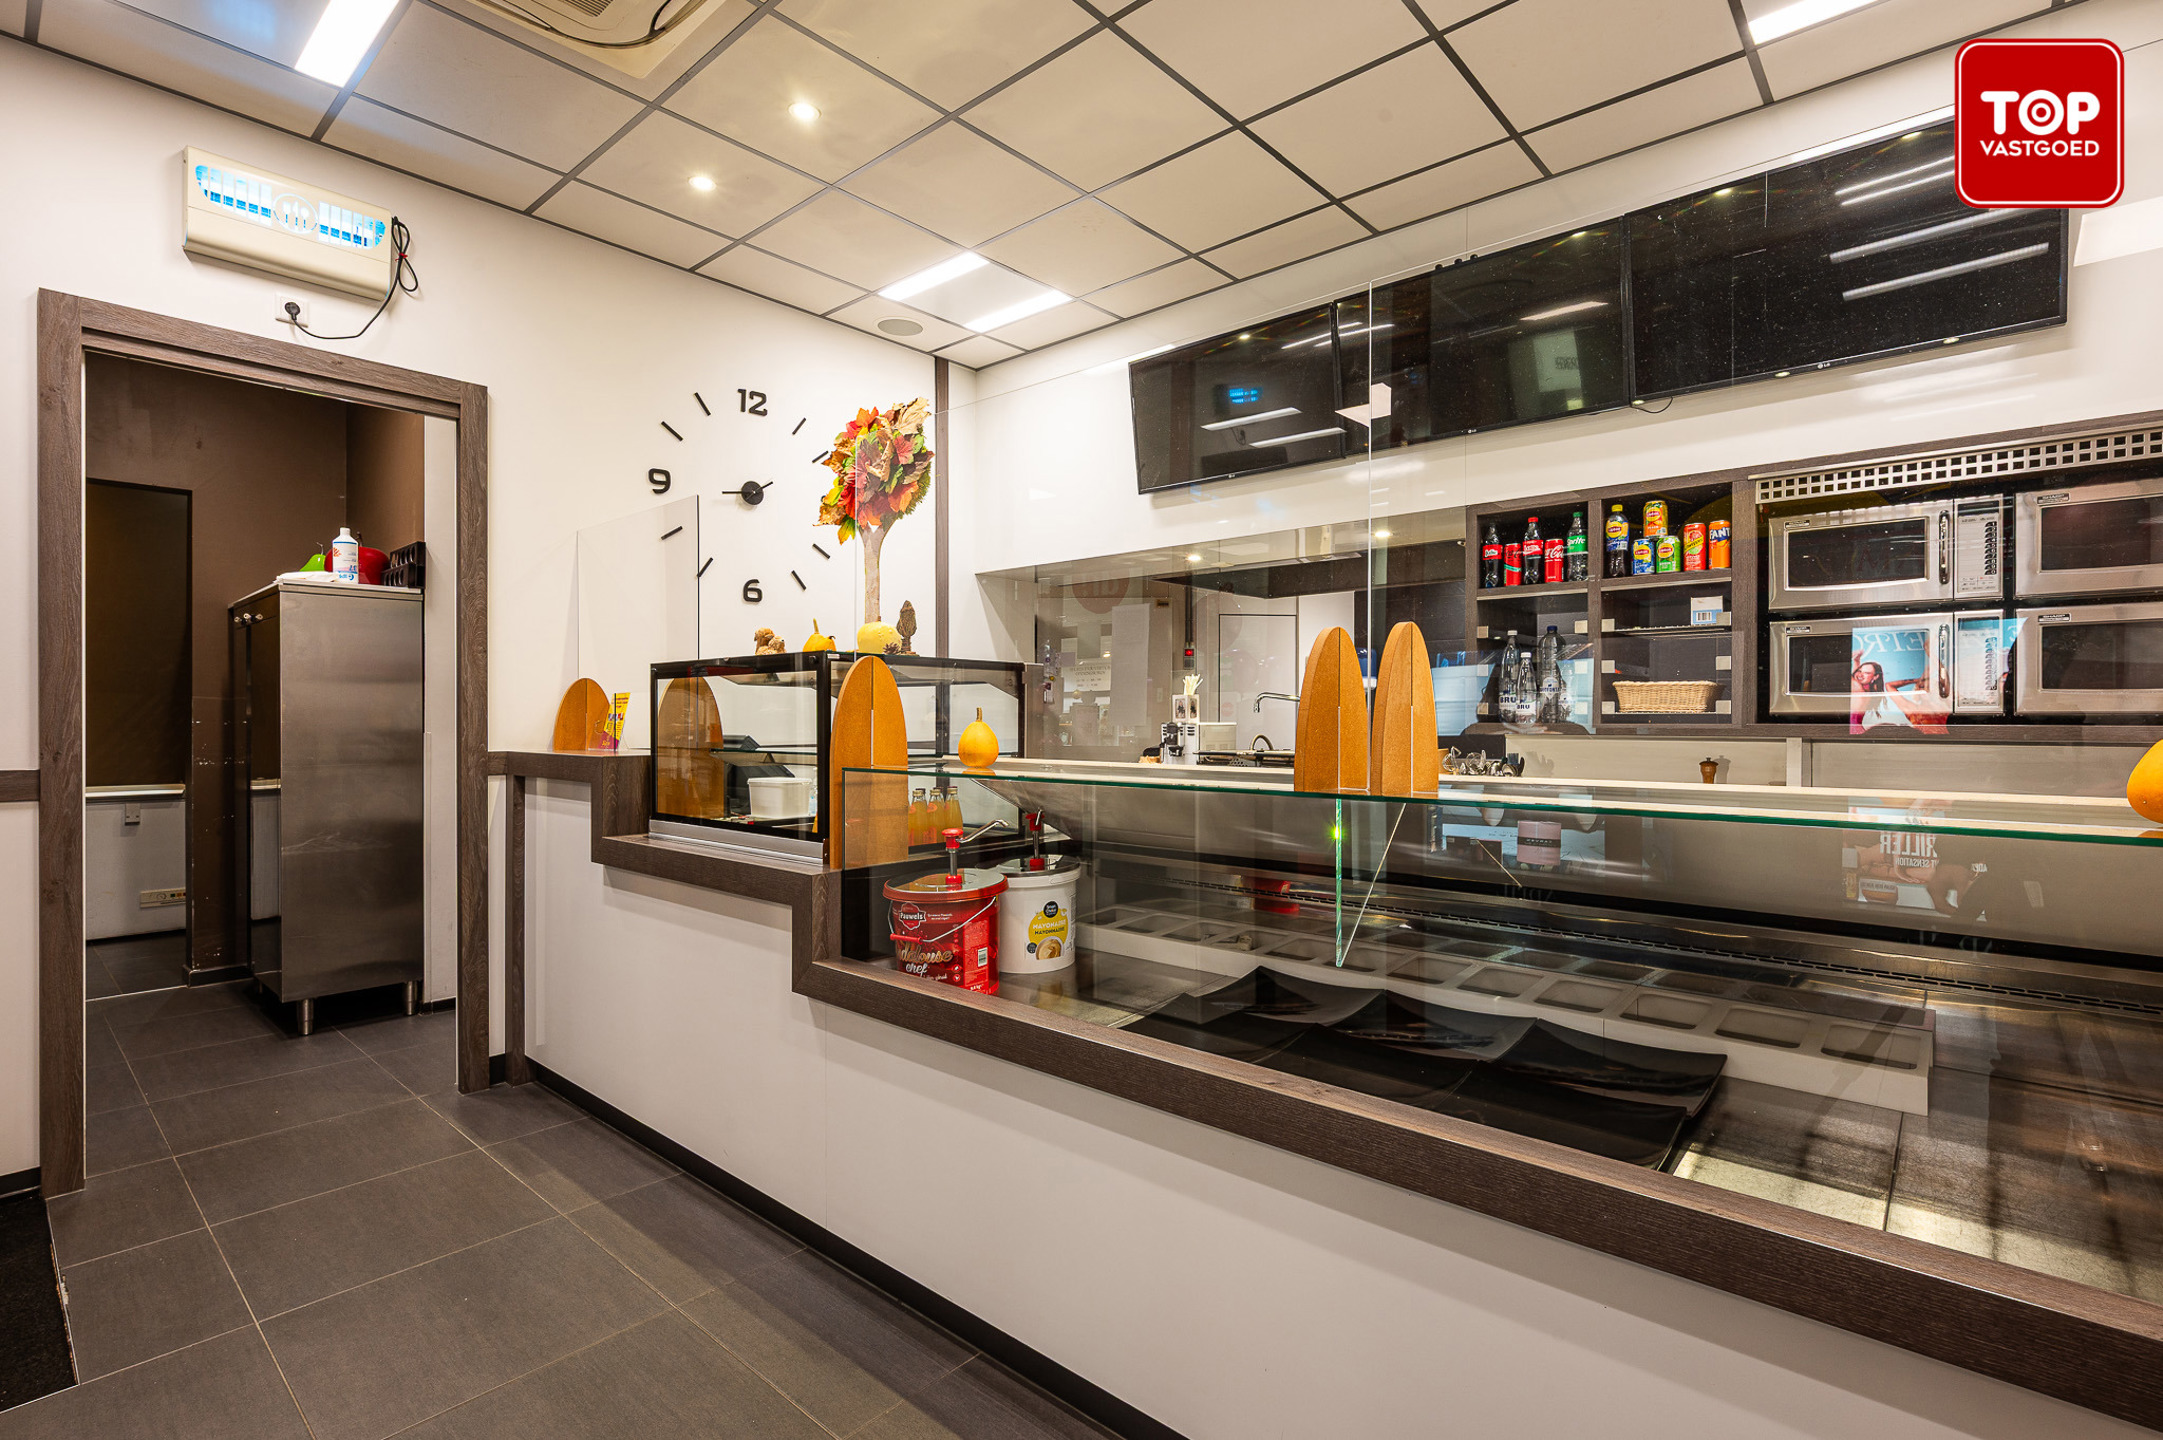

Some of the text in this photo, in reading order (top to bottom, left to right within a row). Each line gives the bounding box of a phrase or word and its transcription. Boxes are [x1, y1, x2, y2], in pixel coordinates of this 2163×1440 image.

[737, 388, 768, 416] 12
[648, 468, 671, 494] 9
[1710, 527, 1731, 540] FANT
[1567, 537, 1586, 547] Sprite
[742, 579, 763, 603] 6
[1500, 696, 1517, 704] BRU
[900, 912, 923, 920] Pauwels
[900, 945, 954, 964] dalouse
